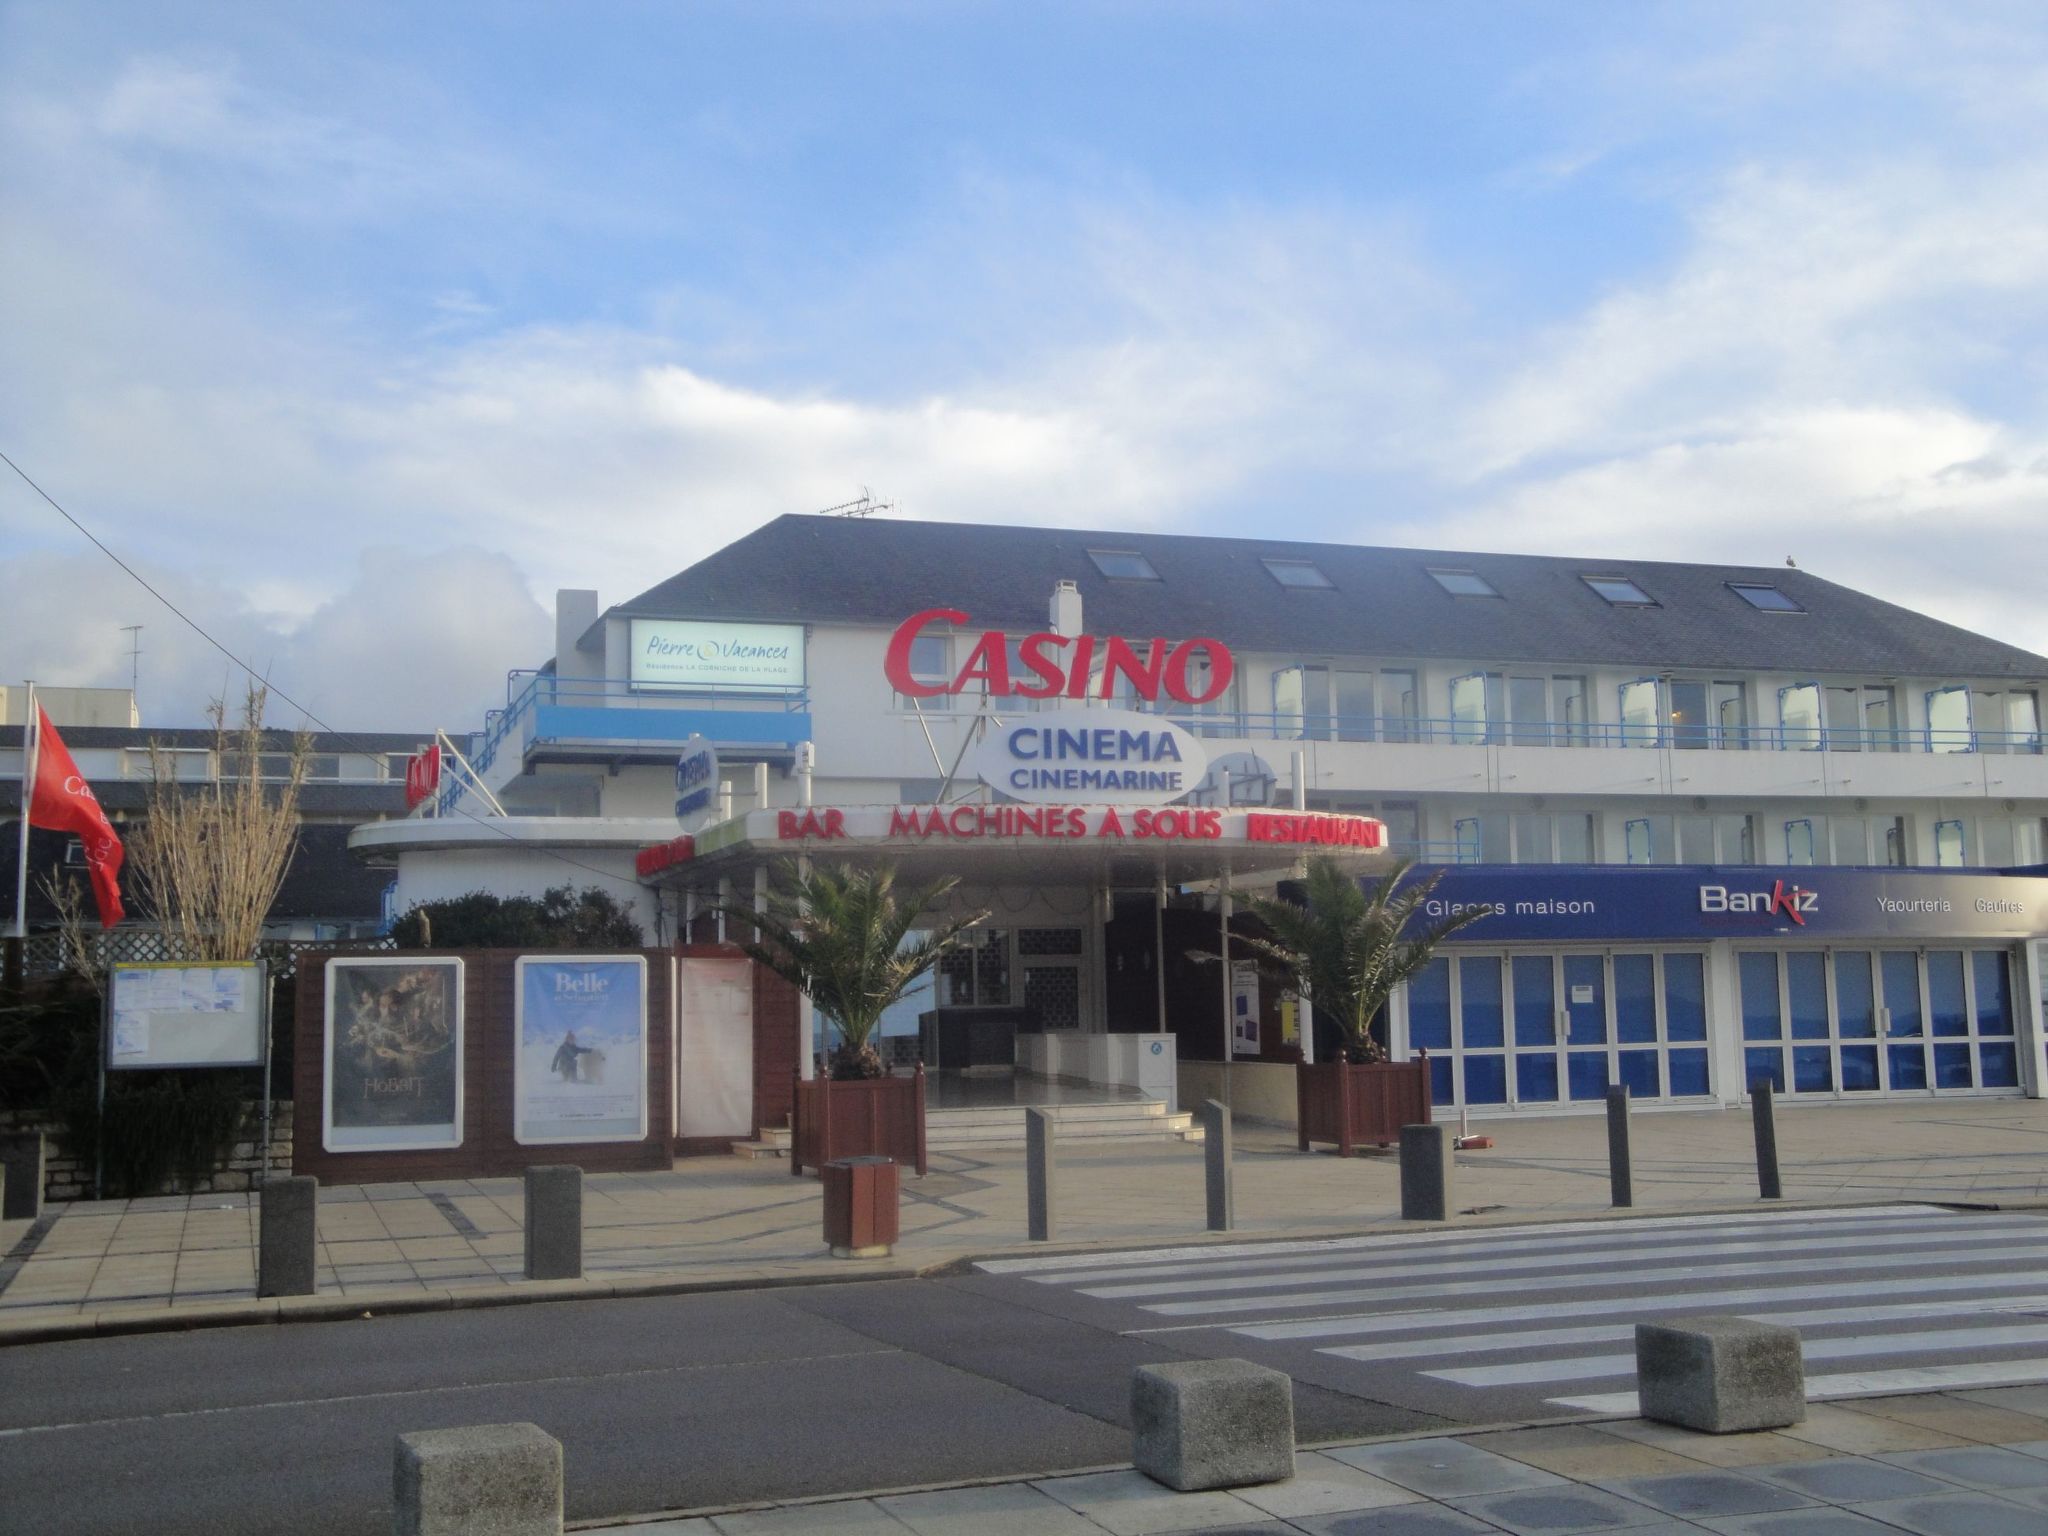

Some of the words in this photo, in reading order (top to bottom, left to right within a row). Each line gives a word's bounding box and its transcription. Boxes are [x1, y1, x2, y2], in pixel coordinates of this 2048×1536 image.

[646, 636, 694, 656] Pierre
[722, 639, 789, 660] Vacances
[884, 608, 1234, 704] CASINO
[698, 664, 737, 672] CORNICHE
[1008, 727, 1183, 763] CINEMA
[1009, 768, 1183, 792] CINEMARINE
[778, 807, 846, 840] BAR
[889, 805, 1086, 838] MACHINES
[1100, 807, 1125, 838] A
[1133, 808, 1222, 840] SOUS
[1247, 812, 1381, 849] RESTAURANT
[1515, 899, 1595, 915] maison
[1699, 880, 1819, 926] Bankiz
[1876, 897, 1952, 913] Yaourteria
[555, 972, 609, 993] Belle
